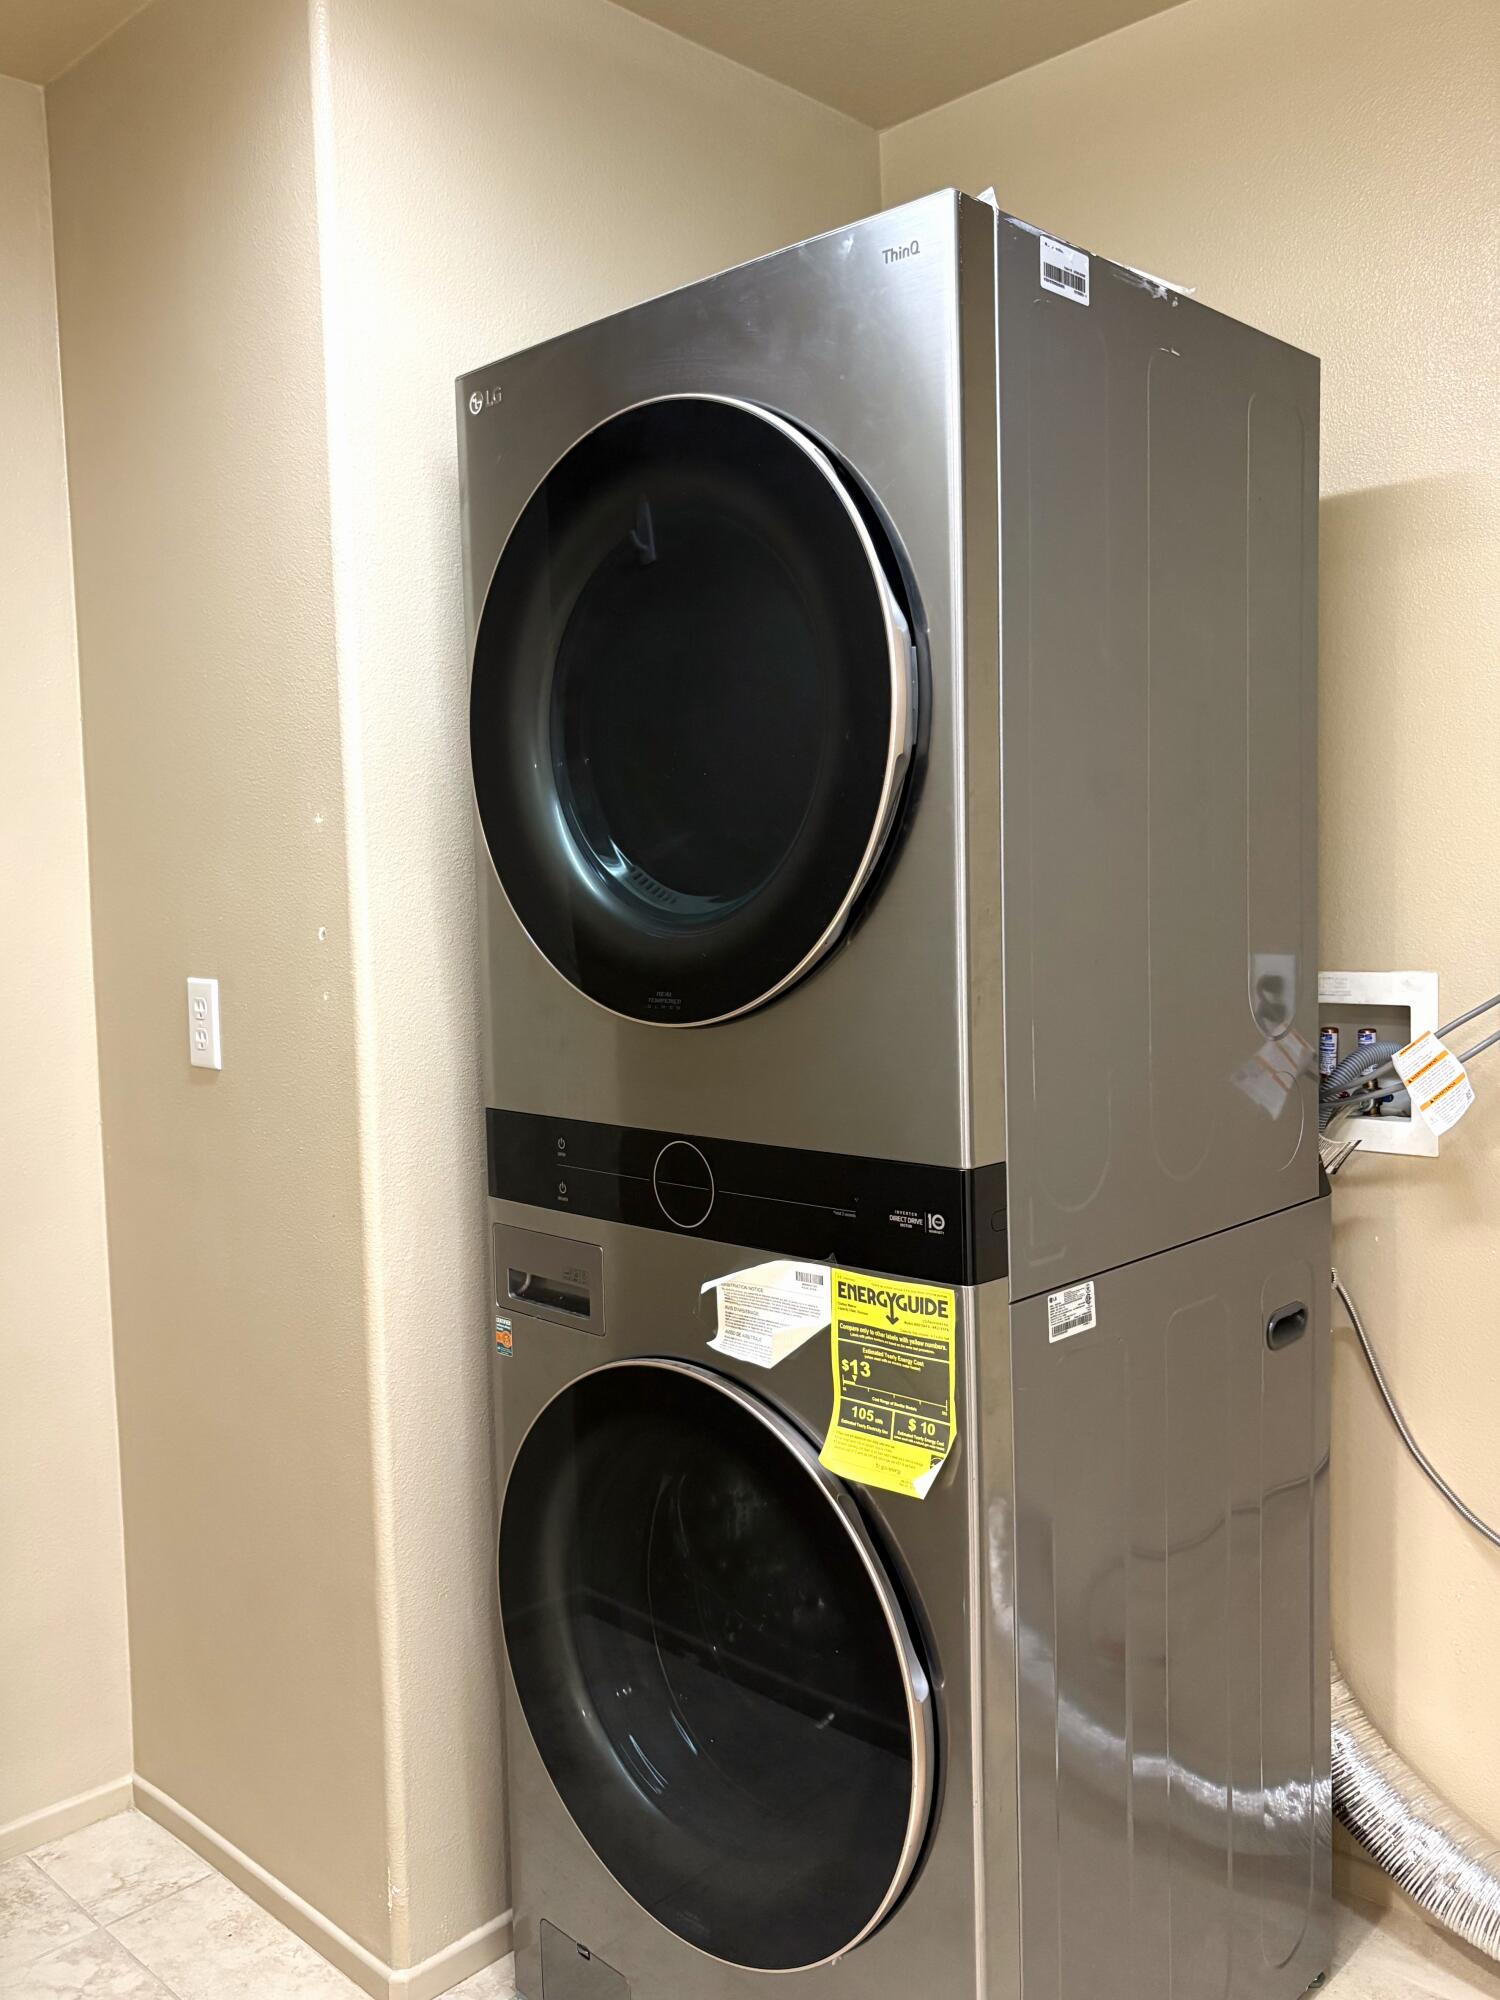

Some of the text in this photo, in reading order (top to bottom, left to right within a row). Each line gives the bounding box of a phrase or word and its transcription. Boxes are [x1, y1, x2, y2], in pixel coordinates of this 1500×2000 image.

[881, 239, 921, 265] ThinQ
[485, 384, 502, 401] LG
[888, 1214, 924, 1226] DIRECT DRIVE
[894, 1209, 918, 1217] INVERTER
[927, 1213, 946, 1231] 10
[838, 1280, 949, 1319] ENERGYGUIDE
[839, 1322, 859, 1333] Compare
[860, 1326, 870, 1336] only
[875, 1330, 886, 1338] other
[886, 1331, 899, 1341] labels
[899, 1335, 909, 1344] with
[909, 1337, 925, 1346] yellow
[862, 1347, 884, 1358] Estimated
[884, 1352, 897, 1361] Yearly
[897, 1355, 913, 1365] Energy
[913, 1359, 925, 1367] Cost
[841, 1358, 871, 1377] $13
[851, 1405, 874, 1422] 105
[907, 1418, 936, 1436] $ 10
